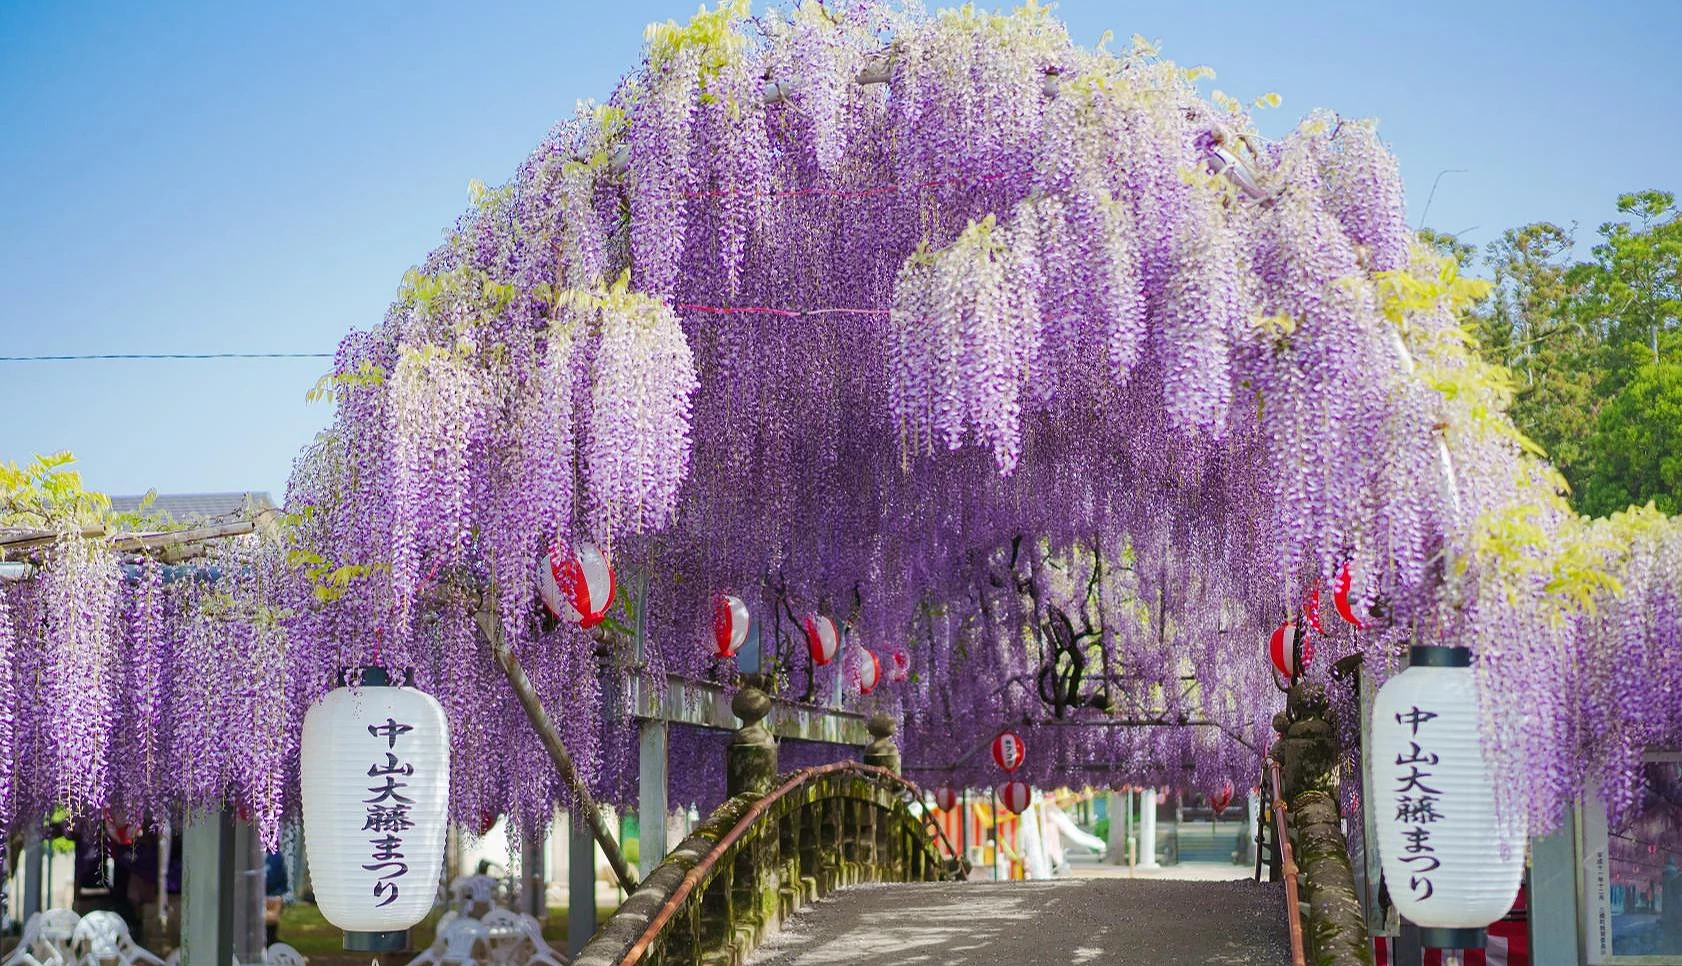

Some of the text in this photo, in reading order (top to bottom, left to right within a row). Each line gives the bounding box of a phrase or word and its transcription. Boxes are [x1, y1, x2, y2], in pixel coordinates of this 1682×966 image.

[361, 718, 416, 908] 中山大藤まつり
[1394, 706, 1445, 902] 中山大藤まつり
